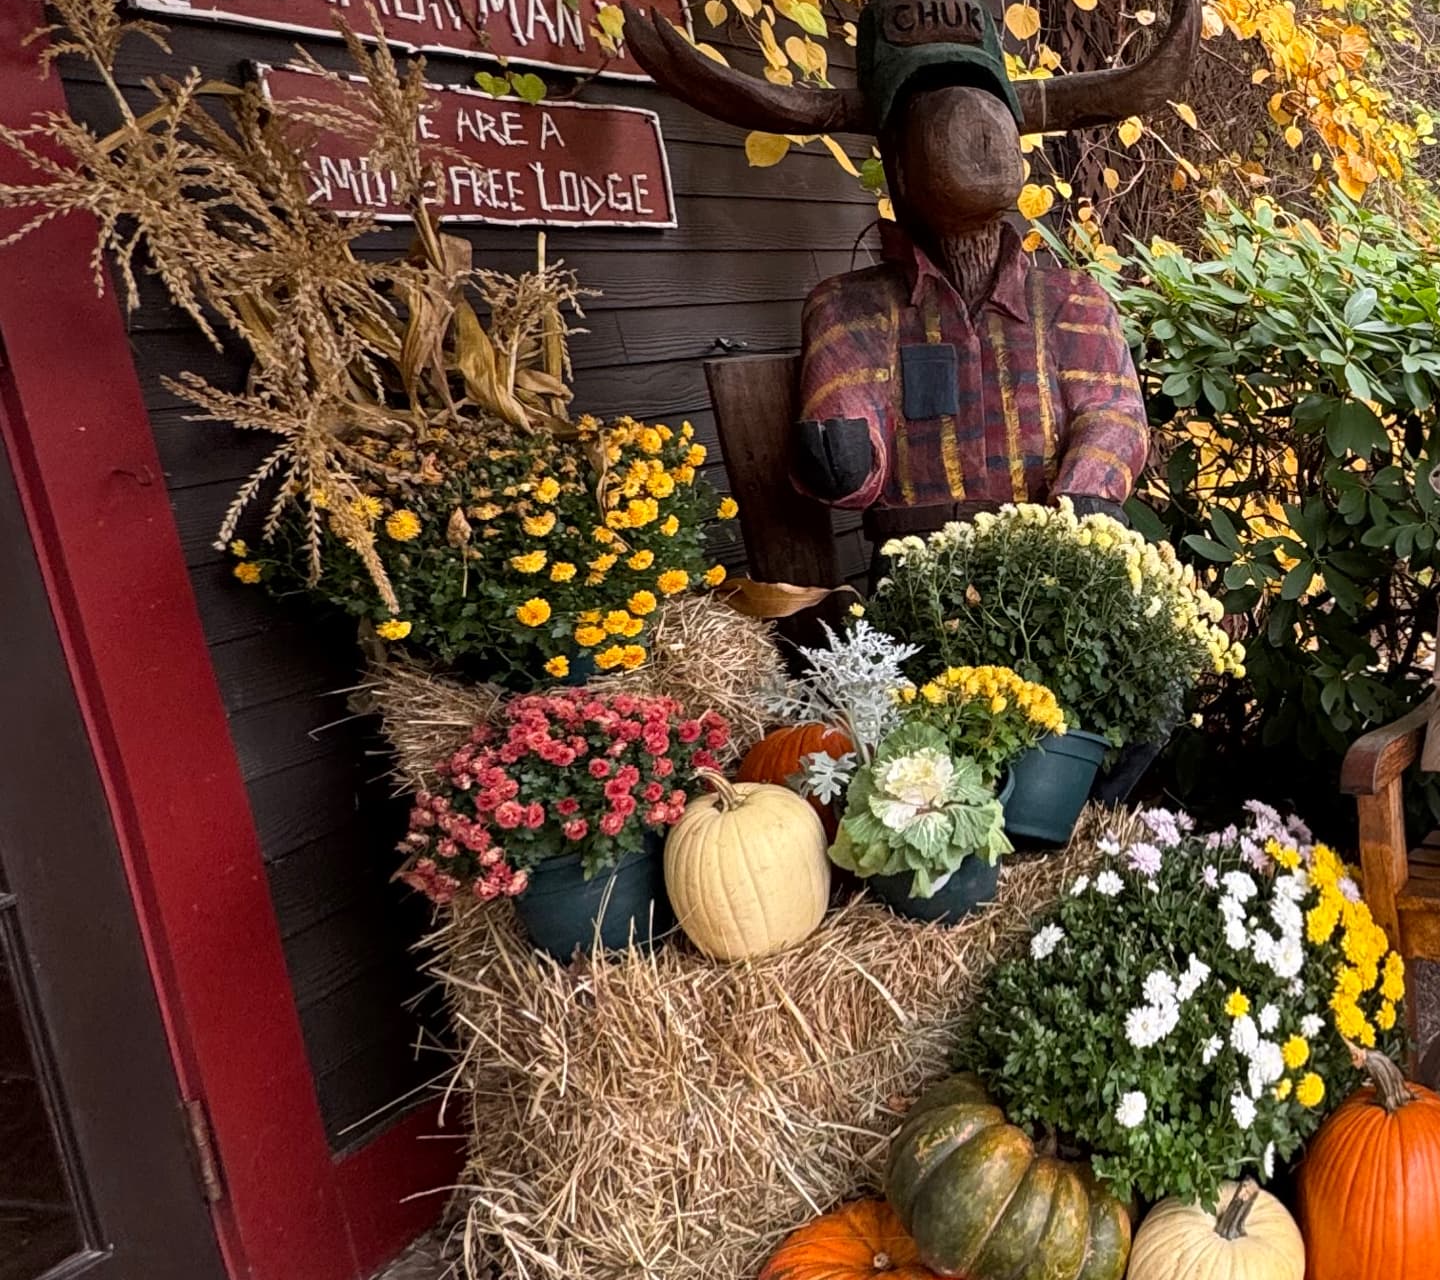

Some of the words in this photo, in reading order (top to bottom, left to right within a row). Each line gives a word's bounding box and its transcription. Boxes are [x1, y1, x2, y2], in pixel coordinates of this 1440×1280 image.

[457, 108, 529, 146] ARE
[540, 111, 565, 149] A
[449, 166, 526, 211] FREE
[529, 161, 654, 216] LODGE
